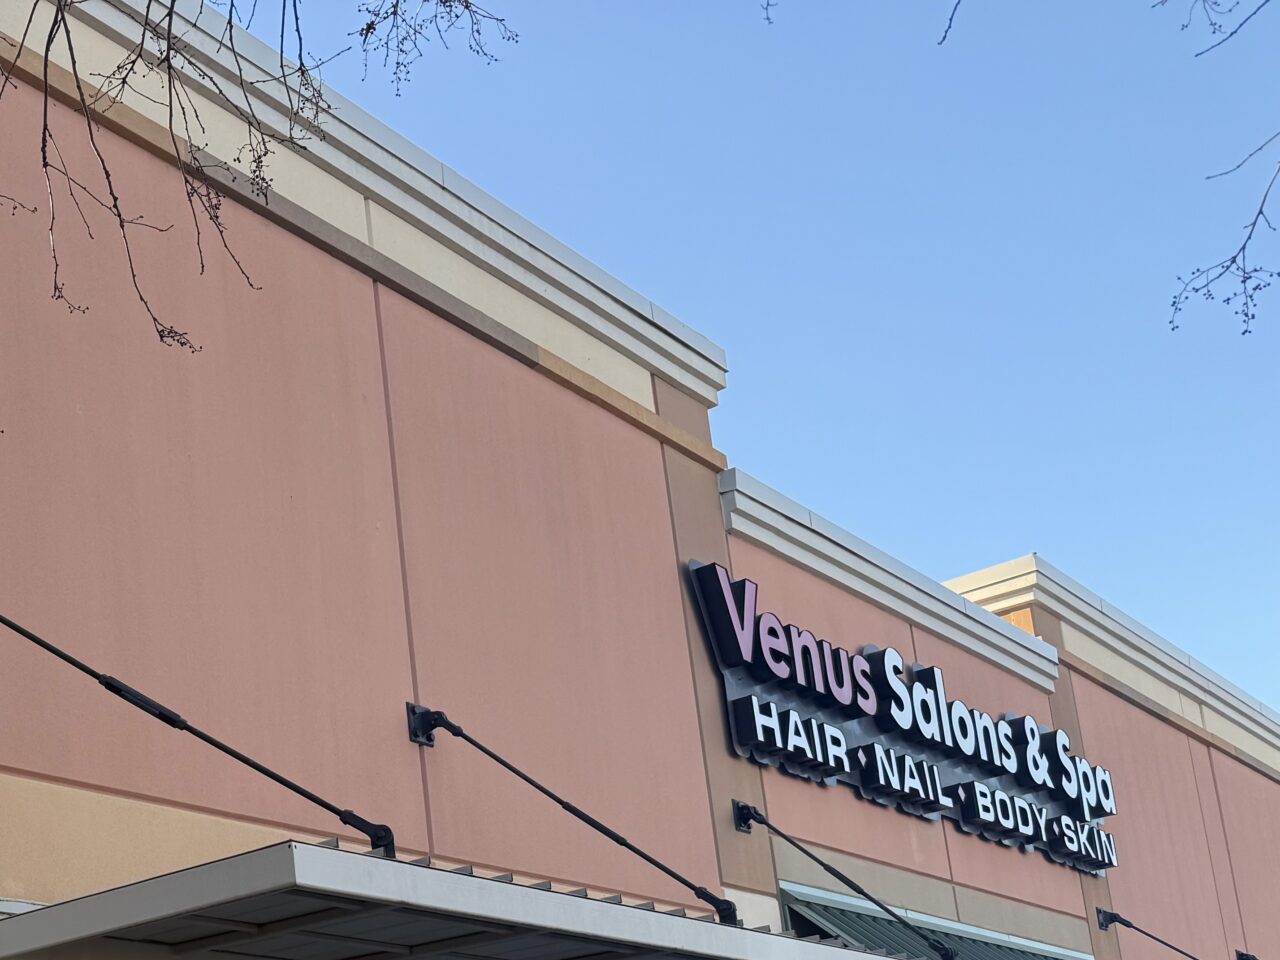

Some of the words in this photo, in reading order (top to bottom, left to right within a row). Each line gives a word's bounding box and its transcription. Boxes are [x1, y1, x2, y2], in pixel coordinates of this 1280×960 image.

[715, 564, 877, 716] Venus
[885, 648, 1018, 773] Salons
[1024, 715, 1055, 788] &
[1056, 729, 1117, 821] Spa
[752, 695, 850, 773] HAIR
[873, 743, 953, 808] NAIL
[974, 781, 1048, 841] BODY
[1060, 815, 1118, 867] SKIN
